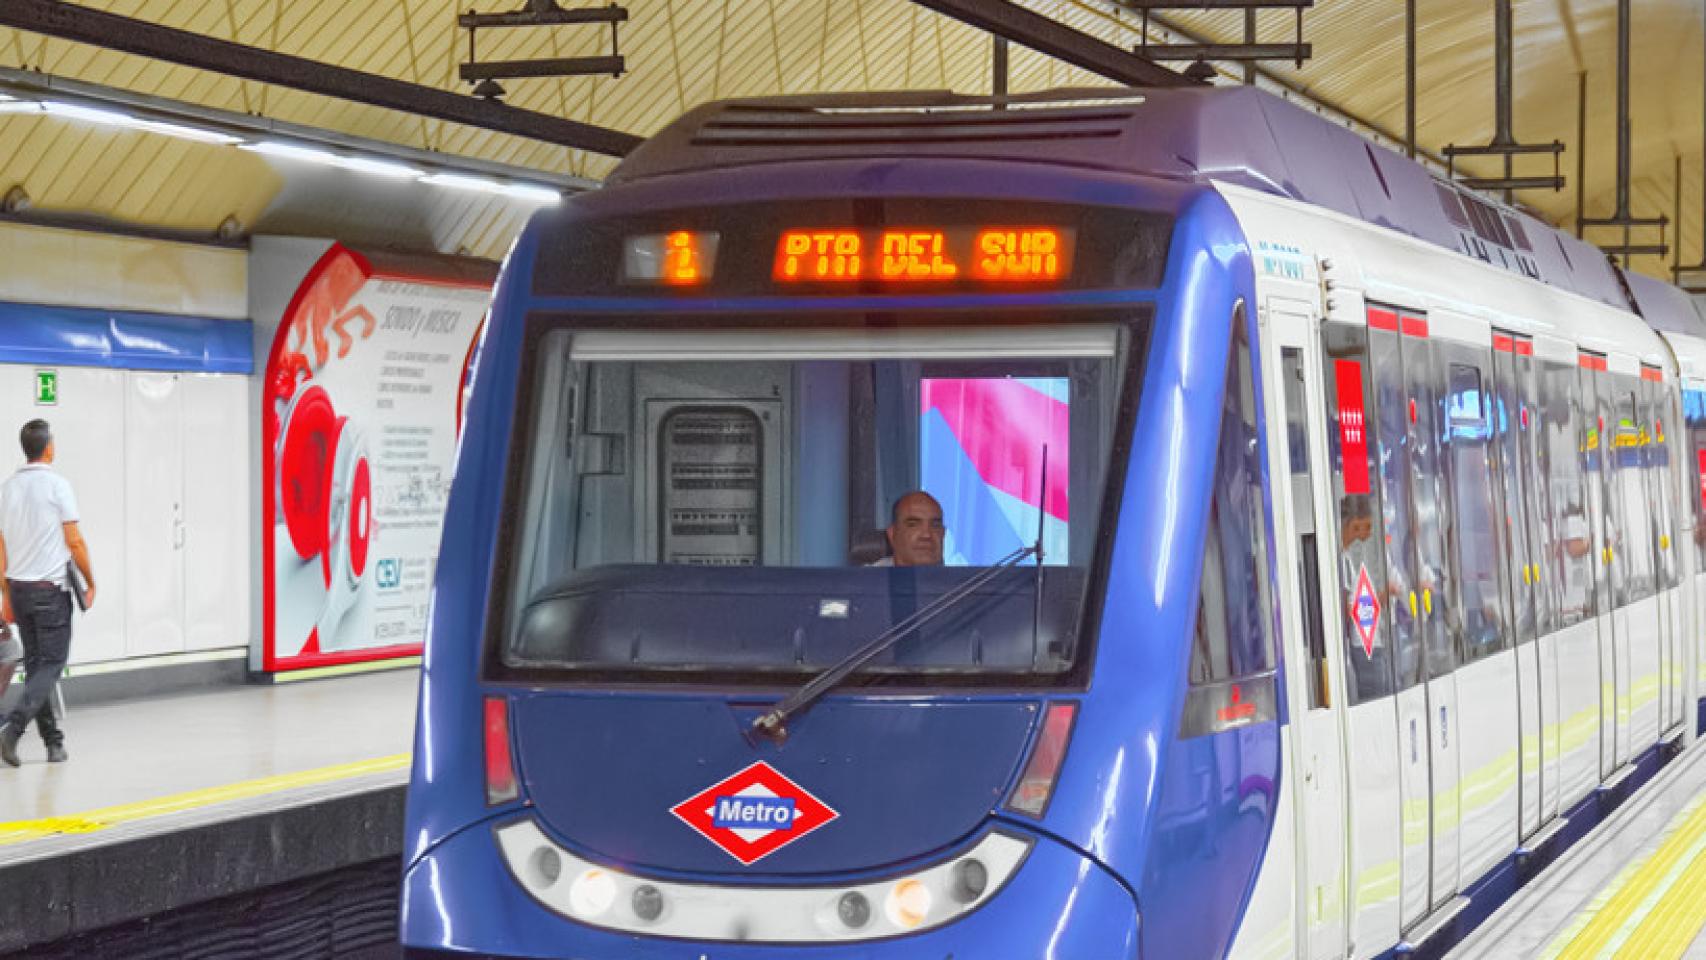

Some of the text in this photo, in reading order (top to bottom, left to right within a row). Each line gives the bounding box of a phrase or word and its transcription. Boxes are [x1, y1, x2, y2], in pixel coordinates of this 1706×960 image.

[784, 232, 1058, 277] PTA DEL SUR
[718, 799, 790, 824] Metro
